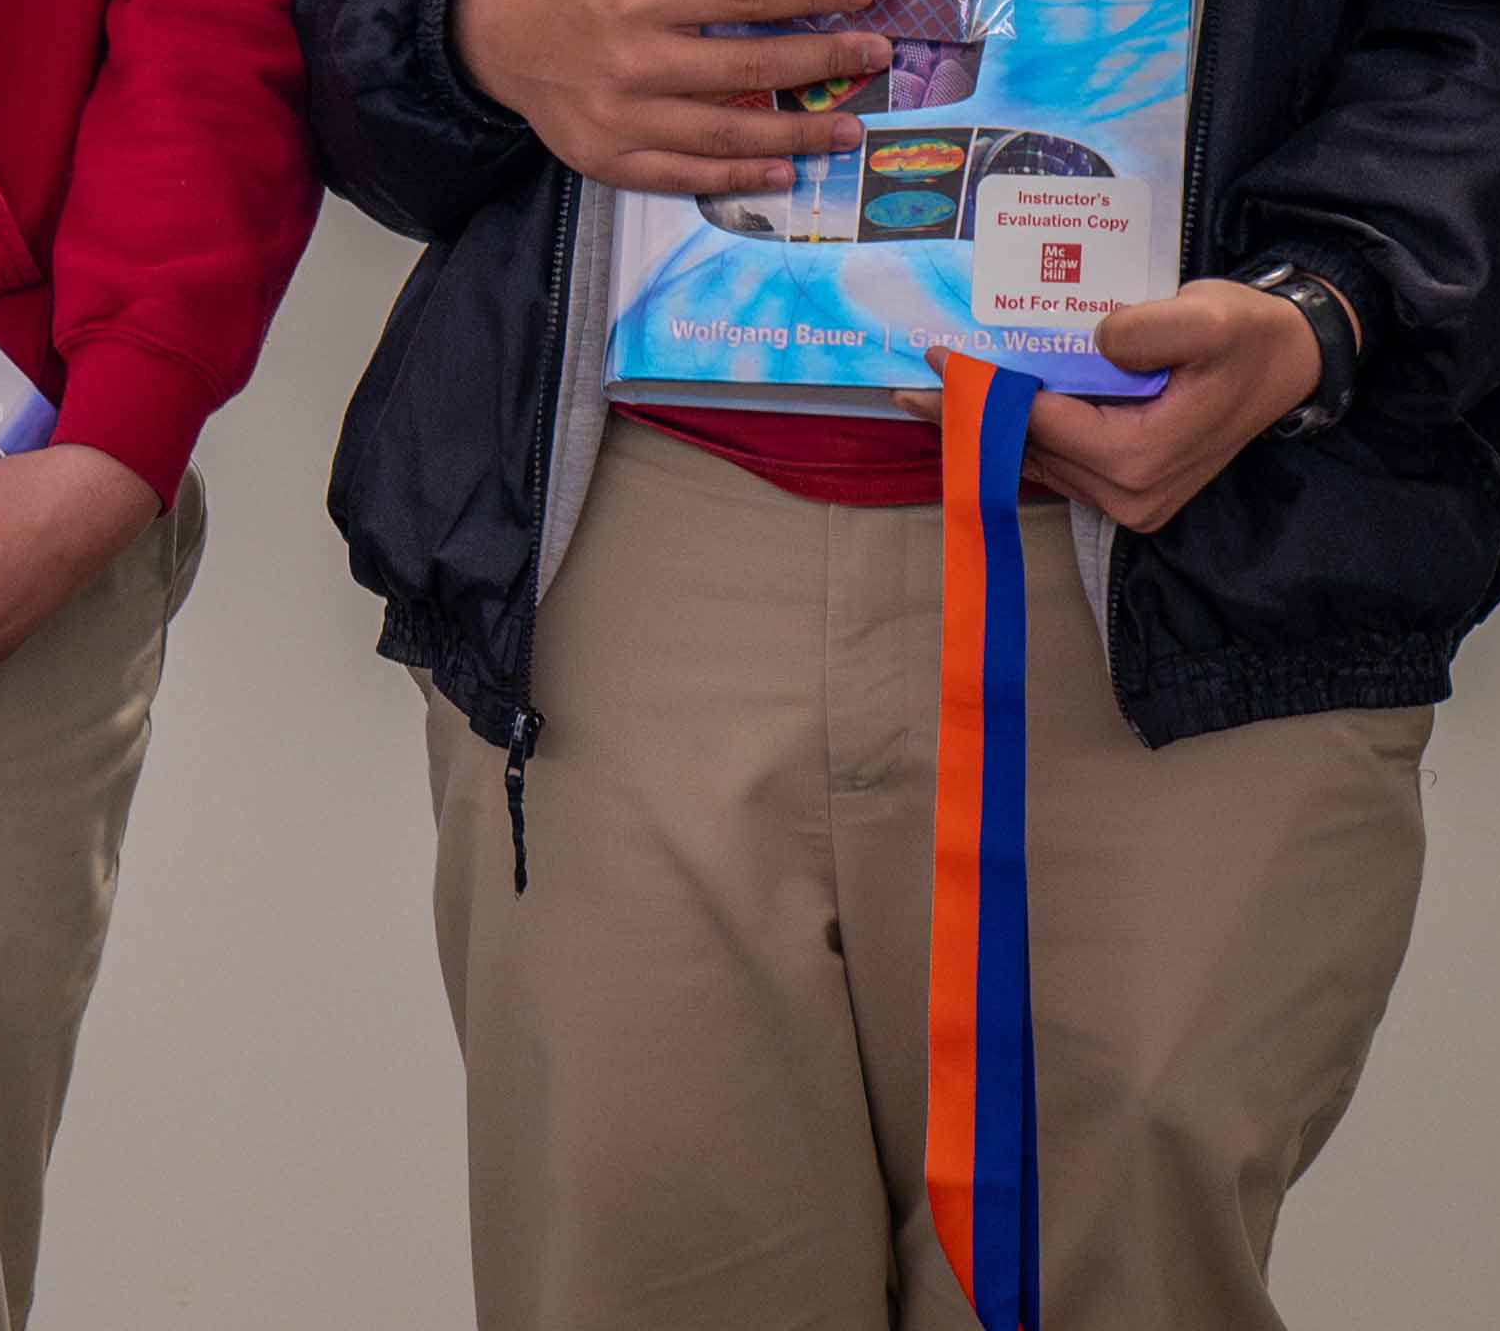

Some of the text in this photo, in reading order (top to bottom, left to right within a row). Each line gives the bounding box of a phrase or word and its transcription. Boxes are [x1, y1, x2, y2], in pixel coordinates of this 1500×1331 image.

[1017, 190, 1111, 207] Instructor's
[997, 212, 1130, 233] Evaluation Copy
[1044, 245, 1065, 258] Mc
[1043, 257, 1079, 269] Graw
[1042, 268, 1066, 281] Hill
[994, 293, 1025, 311] Not
[1030, 295, 1060, 312] For
[669, 319, 867, 351] Wolfgang Bauer
[972, 329, 998, 351] D.
[1002, 330, 1101, 355] Westfal
